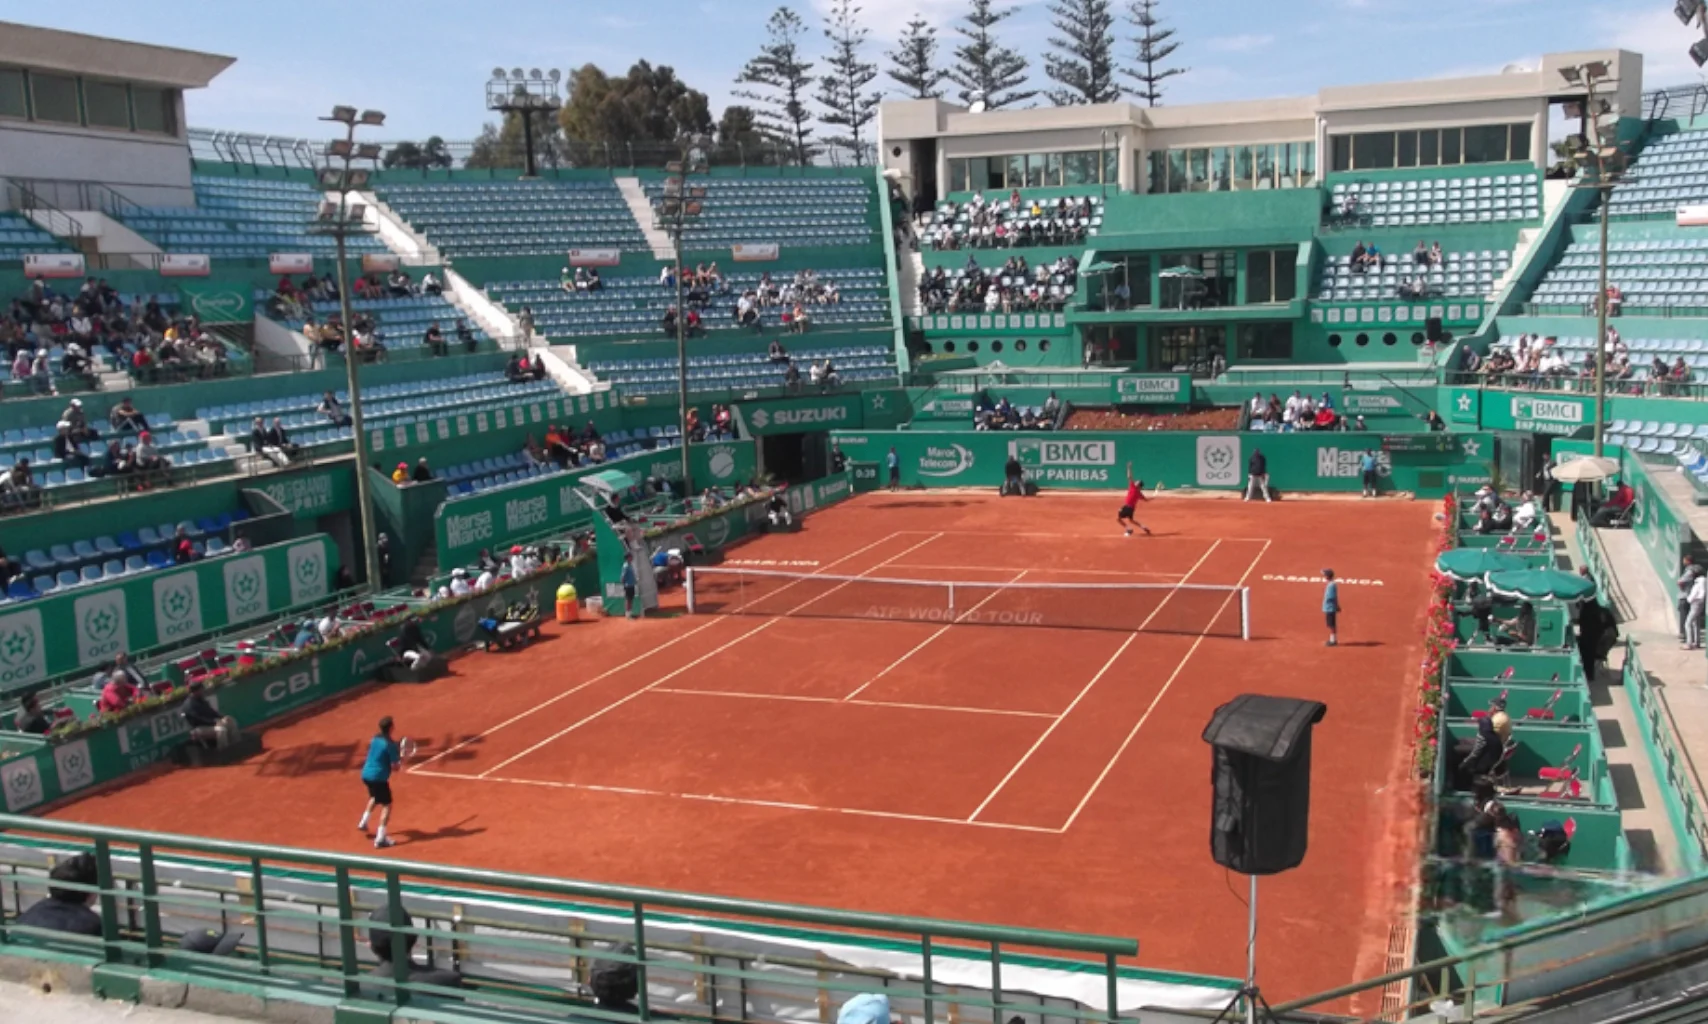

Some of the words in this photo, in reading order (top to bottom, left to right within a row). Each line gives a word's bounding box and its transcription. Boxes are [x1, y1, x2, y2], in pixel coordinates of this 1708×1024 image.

[1140, 380, 1176, 390] BMCI
[774, 406, 847, 424] SUZUKI
[1535, 402, 1576, 418] BMCI
[927, 447, 957, 458] Maroc
[1046, 444, 1106, 461] BMCI
[1317, 447, 1391, 464] Mara
[919, 458, 957, 469] Telecom
[1317, 462, 1392, 477] Marc
[1047, 469, 1108, 481] PARIBAS
[1205, 471, 1232, 480] OCP
[506, 495, 547, 517] Marsa
[446, 510, 491, 532] Marsa
[507, 509, 548, 532] Maroc
[447, 525, 493, 549] Maroc
[235, 602, 262, 617] OCP
[865, 604, 900, 618] ATP
[989, 610, 1043, 624] TOUR
[166, 620, 195, 636] OCP
[88, 640, 120, 658] OCP
[2, 664, 36, 681] OCP
